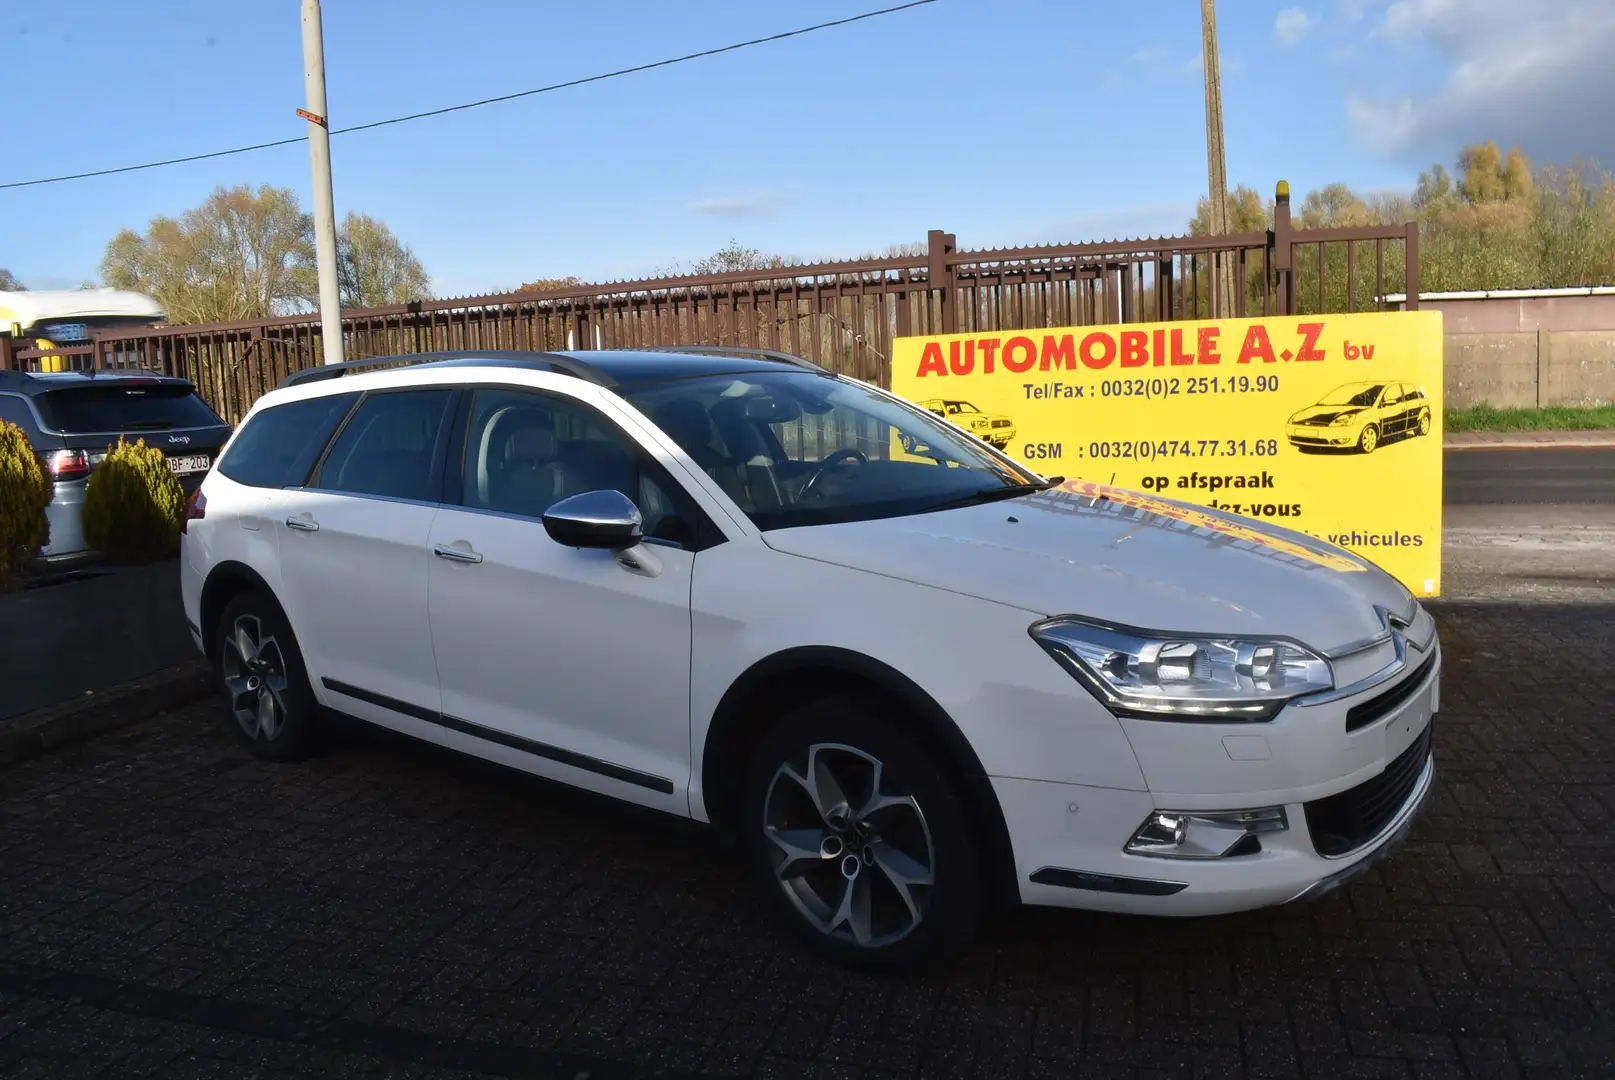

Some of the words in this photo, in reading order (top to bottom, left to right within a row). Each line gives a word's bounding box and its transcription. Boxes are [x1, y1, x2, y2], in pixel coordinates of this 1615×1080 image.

[916, 327, 1222, 378] AUTOMOBILE
[1237, 322, 1326, 364] A.Z
[1343, 340, 1375, 361] bv
[1023, 382, 1084, 399] Tel/Fax
[1101, 379, 1180, 400] 0032(0)2
[1186, 375, 1279, 396] 251.19.90
[168, 435, 190, 444] Jeep
[1023, 443, 1062, 459] GSM
[1089, 439, 1278, 461] 0032(0)474.77.31.68
[1141, 476, 1169, 492] op
[1176, 471, 1274, 492] afspraak
[1328, 530, 1423, 547] vehicules
